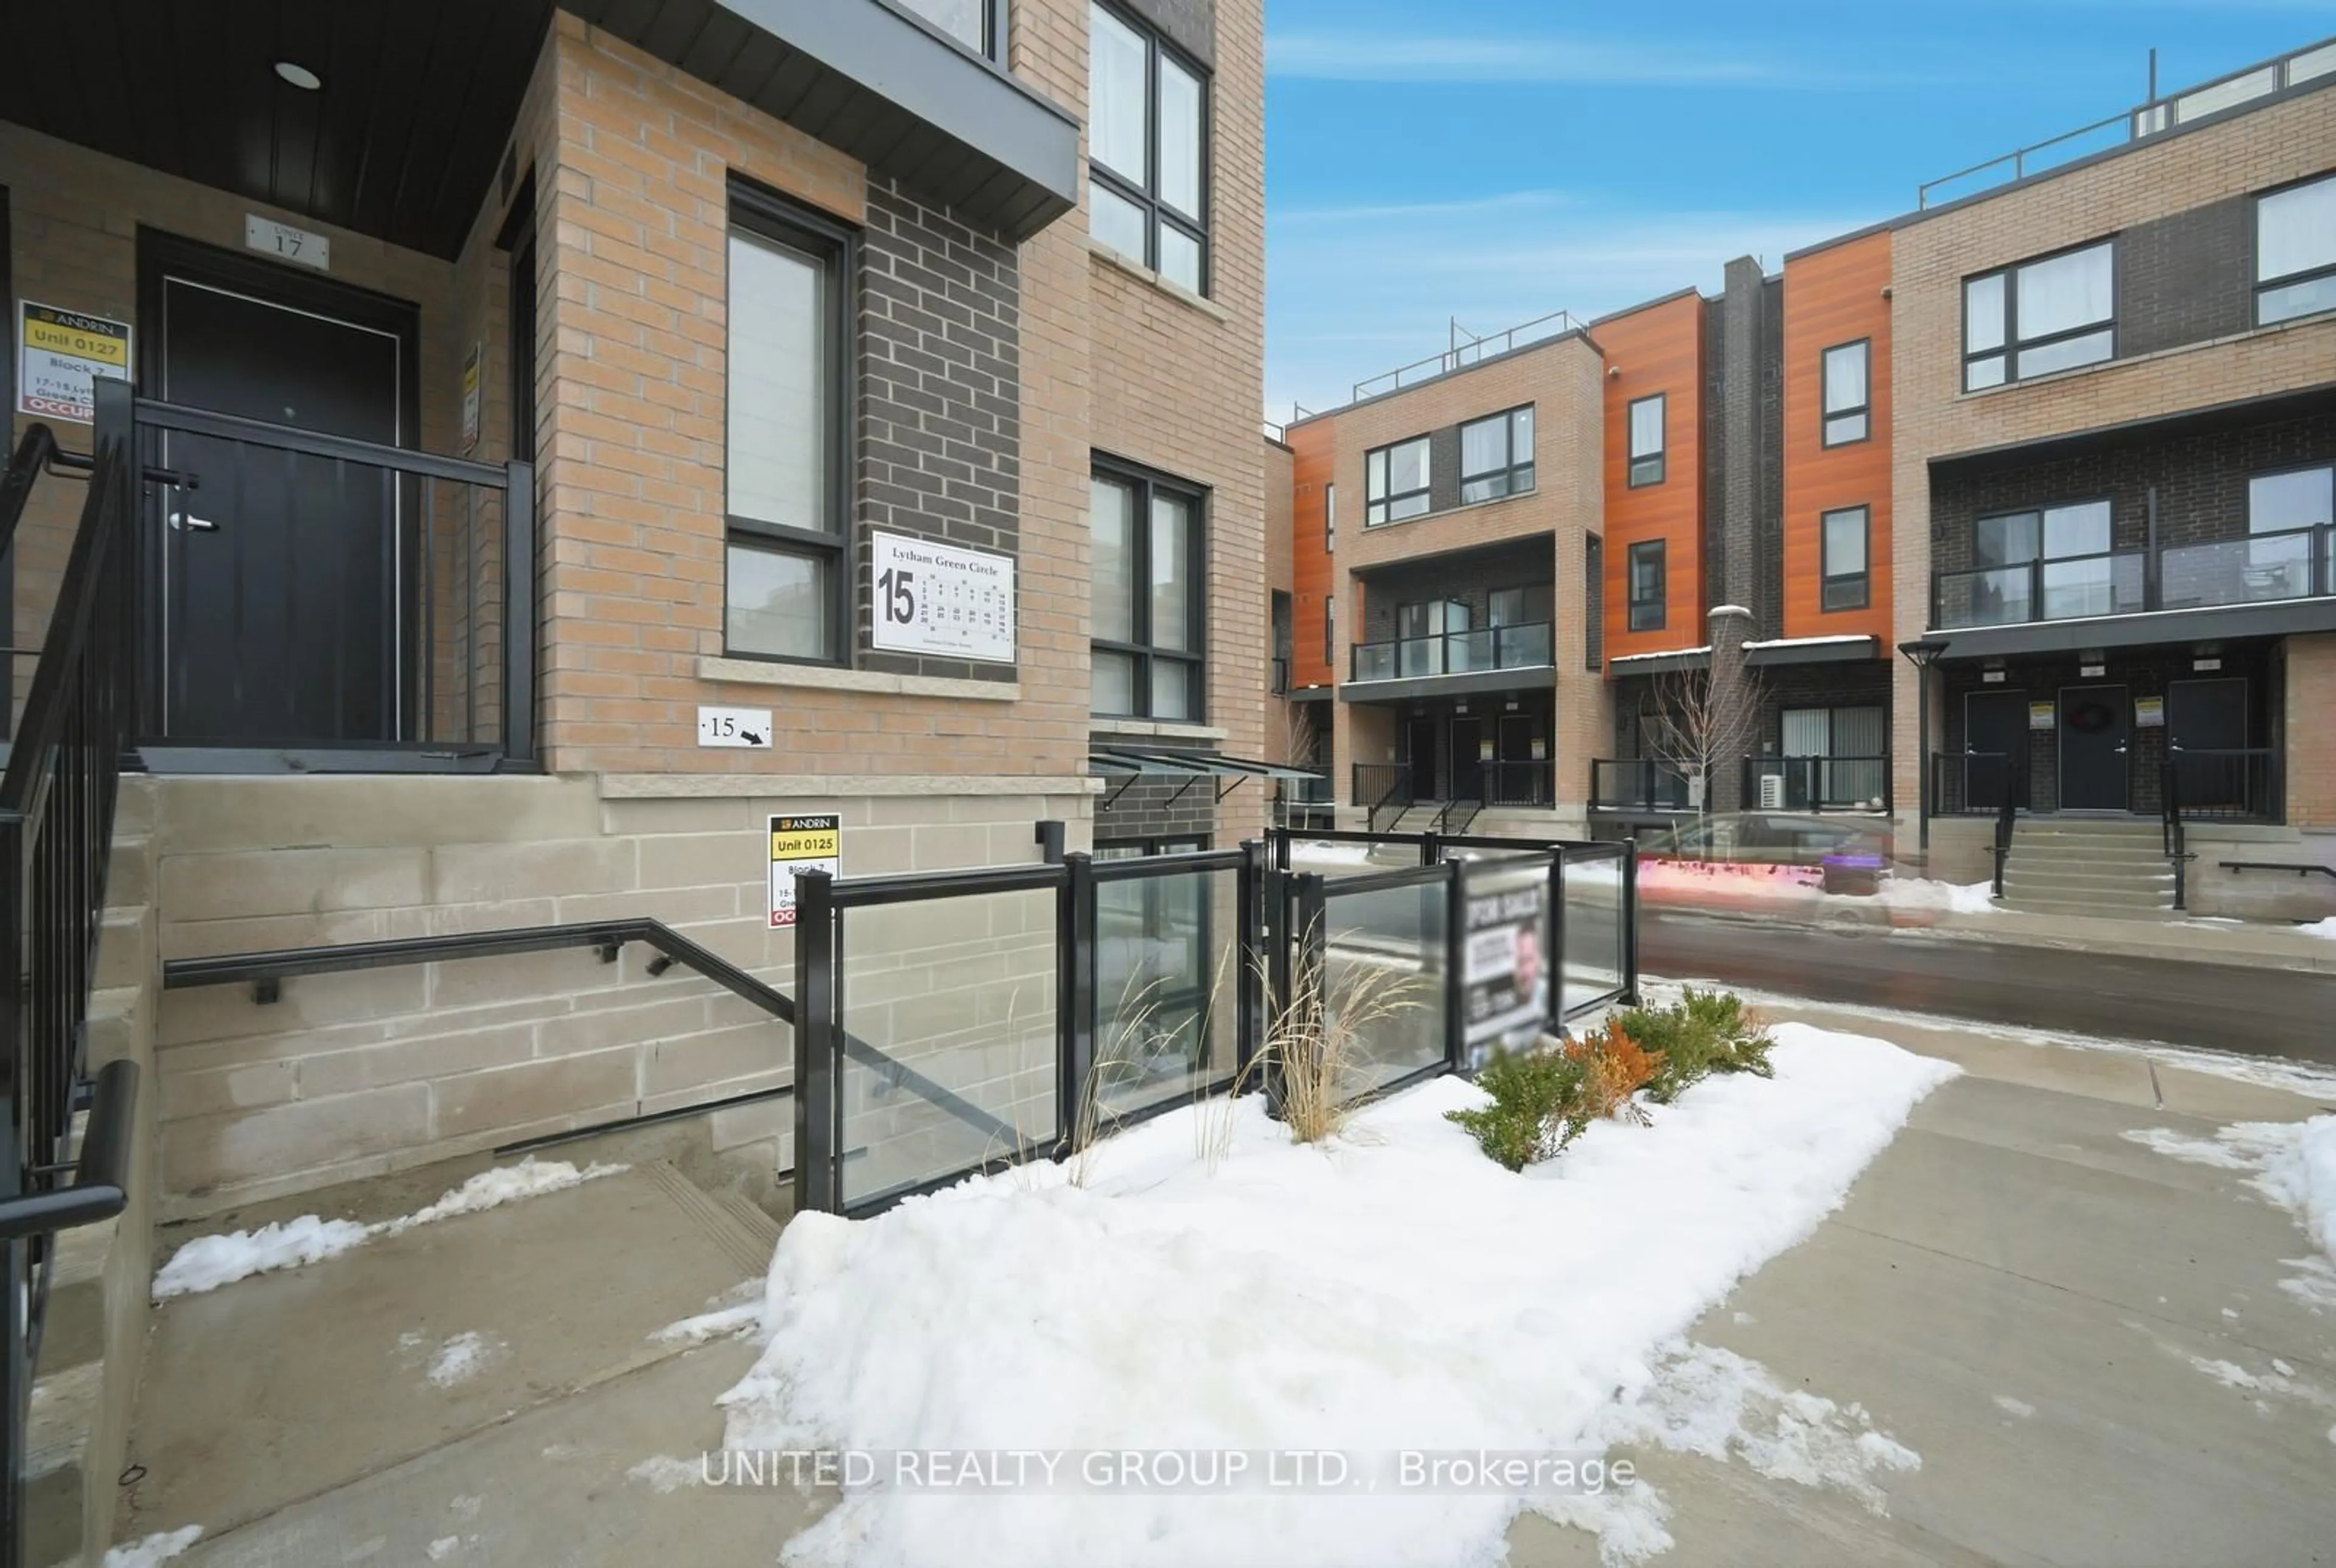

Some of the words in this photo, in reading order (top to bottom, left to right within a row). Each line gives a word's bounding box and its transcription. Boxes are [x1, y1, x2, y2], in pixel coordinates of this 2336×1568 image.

[277, 235, 302, 256] 17
[57, 314, 114, 335] ANDRIN
[35, 329, 70, 346] Unit
[75, 338, 118, 356] 0127
[49, 357, 91, 375] Block
[29, 398, 94, 418] OCCUP
[892, 547, 933, 564] Lytham
[936, 555, 967, 571] Green
[969, 562, 999, 577] Circle
[878, 567, 915, 624] 15
[712, 718, 734, 737] 15
[793, 819, 830, 829] ANDRIN
[777, 841, 802, 852] Unit
[804, 838, 833, 850] 0125
